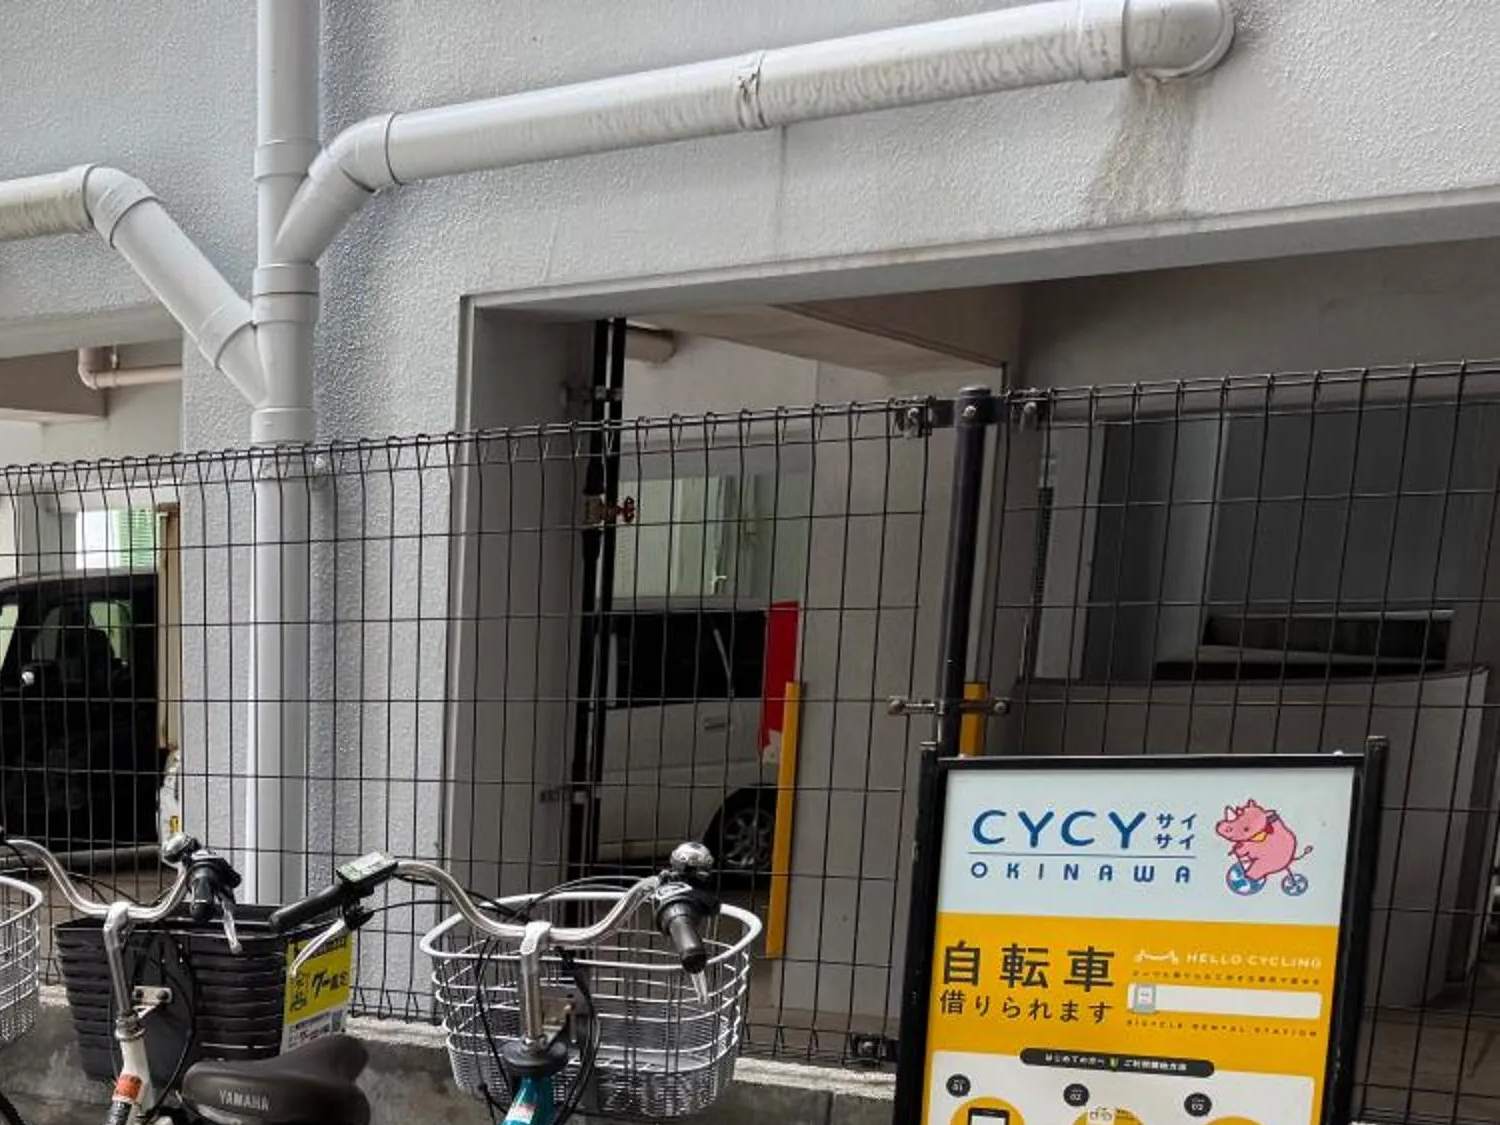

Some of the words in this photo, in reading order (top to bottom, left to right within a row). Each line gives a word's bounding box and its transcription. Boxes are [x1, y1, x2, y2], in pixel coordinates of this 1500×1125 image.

[972, 809, 1148, 850] CYCY
[1155, 812, 1197, 831] サイ
[1154, 832, 1196, 851] サイ
[970, 861, 1192, 884] OKINAWA
[943, 939, 1115, 992] 自転車
[1187, 952, 1243, 966] HELLO
[1248, 954, 1322, 969] CYCLING
[939, 988, 1113, 1024] 借りられます
